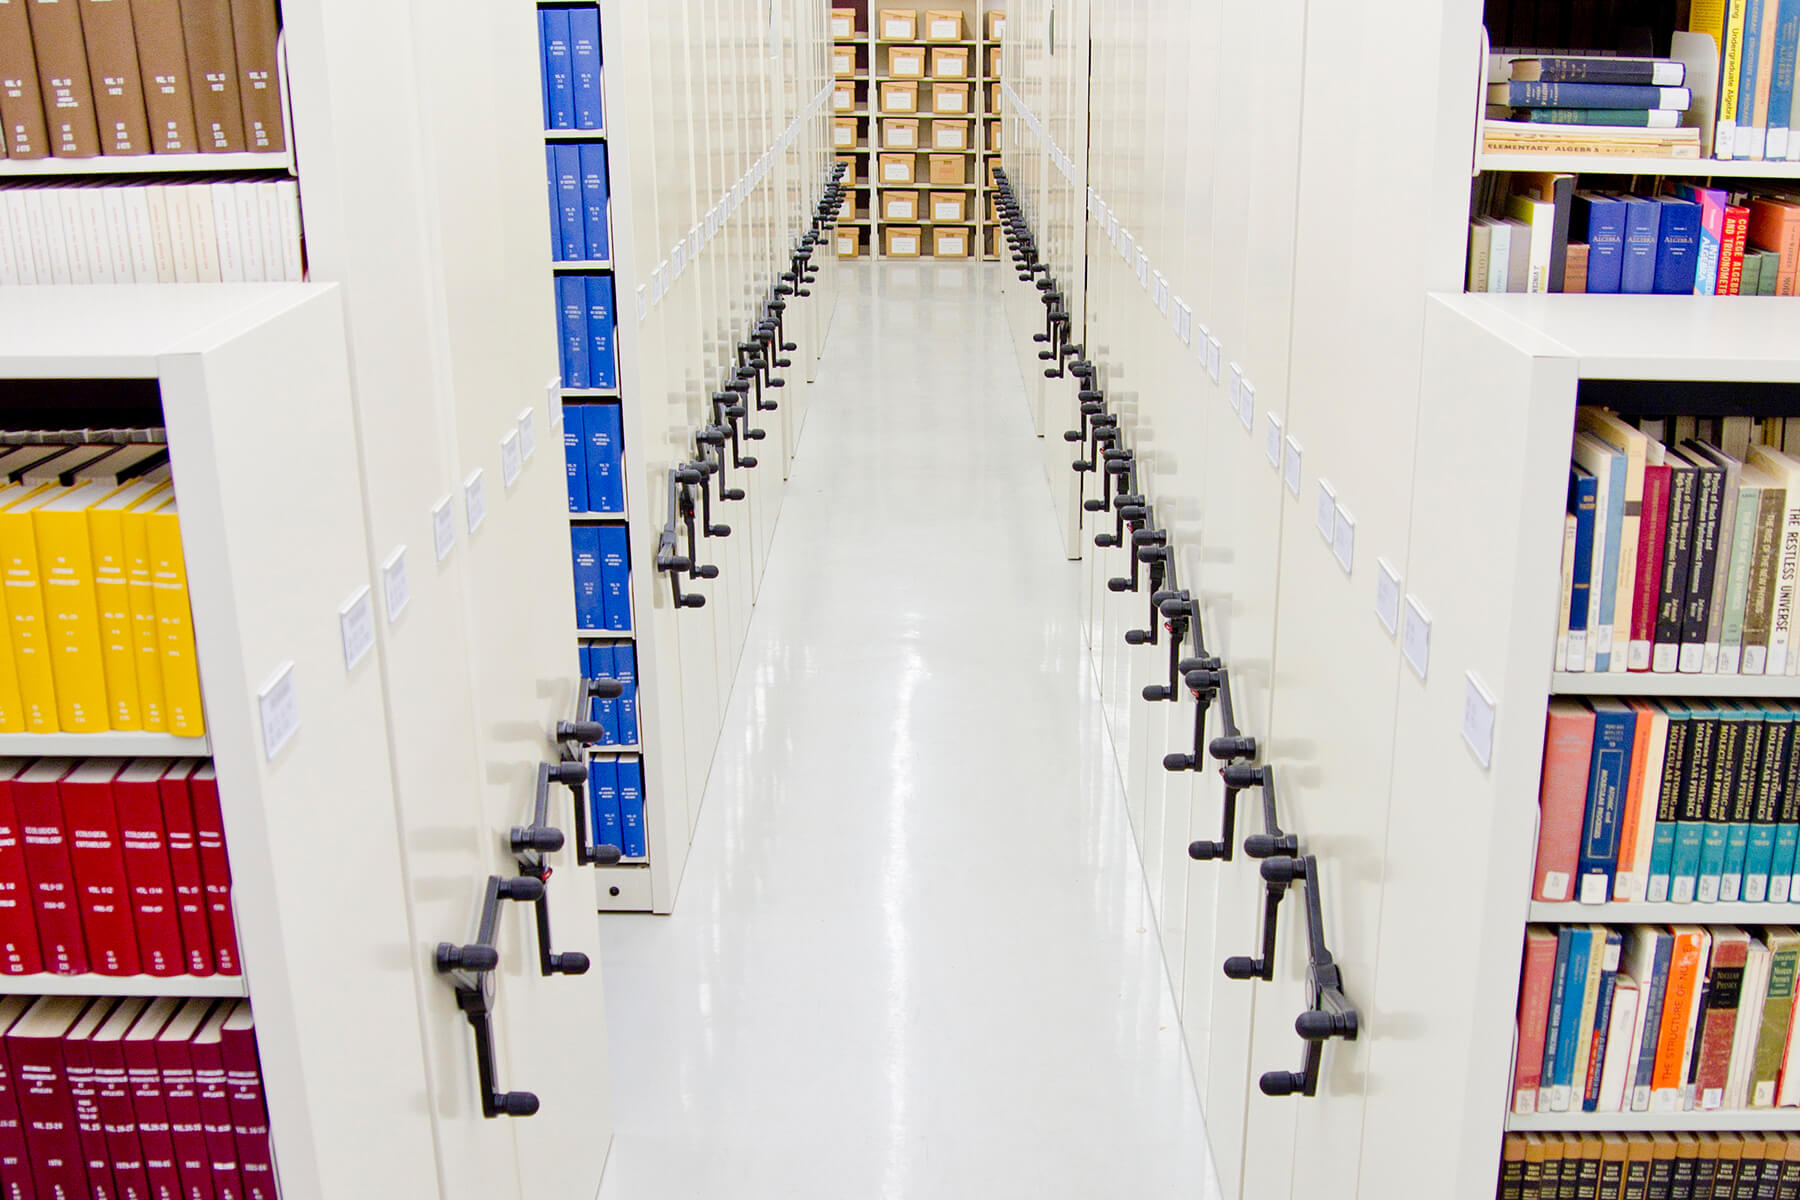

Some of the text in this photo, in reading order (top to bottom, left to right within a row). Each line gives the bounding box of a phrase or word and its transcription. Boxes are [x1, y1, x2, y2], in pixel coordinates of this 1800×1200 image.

[1727, 28, 1739, 86] Undergraduate
[1725, 89, 1734, 120] Algebra
[1488, 144, 1549, 152] ELEMENTARY
[1718, 218, 1736, 296] AND TRIGONOMETR
[1729, 218, 1746, 296] COLLEGE ALGEBR
[1765, 515, 1774, 527] THE
[1776, 508, 1800, 632] THE RESTLESS UNIVERSE
[1676, 724, 1687, 760] Advances
[1702, 722, 1714, 757] Advances
[1727, 724, 1738, 759] Advances
[1752, 725, 1762, 760] Advances
[1775, 725, 1786, 760] Advances
[1659, 725, 1679, 819] MOLECULAR PHYSICS
[1686, 723, 1705, 816] MOLECULAR PHYSICS
[1698, 768, 1708, 803] ATOMIC
[1708, 724, 1729, 819] MOLECULAR PHYSICS
[1721, 768, 1732, 805] ATOMIC
[1735, 725, 1755, 819] MOLECULAR PHYSICS
[1757, 726, 1777, 819] MOLECULAR PHYSICS
[1783, 725, 1800, 819] MOLECULAR PHYSICS
[1671, 770, 1681, 805] ATOMIC
[1746, 770, 1757, 805] ATOMIC
[1768, 771, 1779, 805] ATOMIC
[1766, 807, 1774, 821] and
[1676, 983, 1686, 997] OF
[1665, 1000, 1683, 1058] STRUCTURE
[1662, 1063, 1672, 1080] THE
